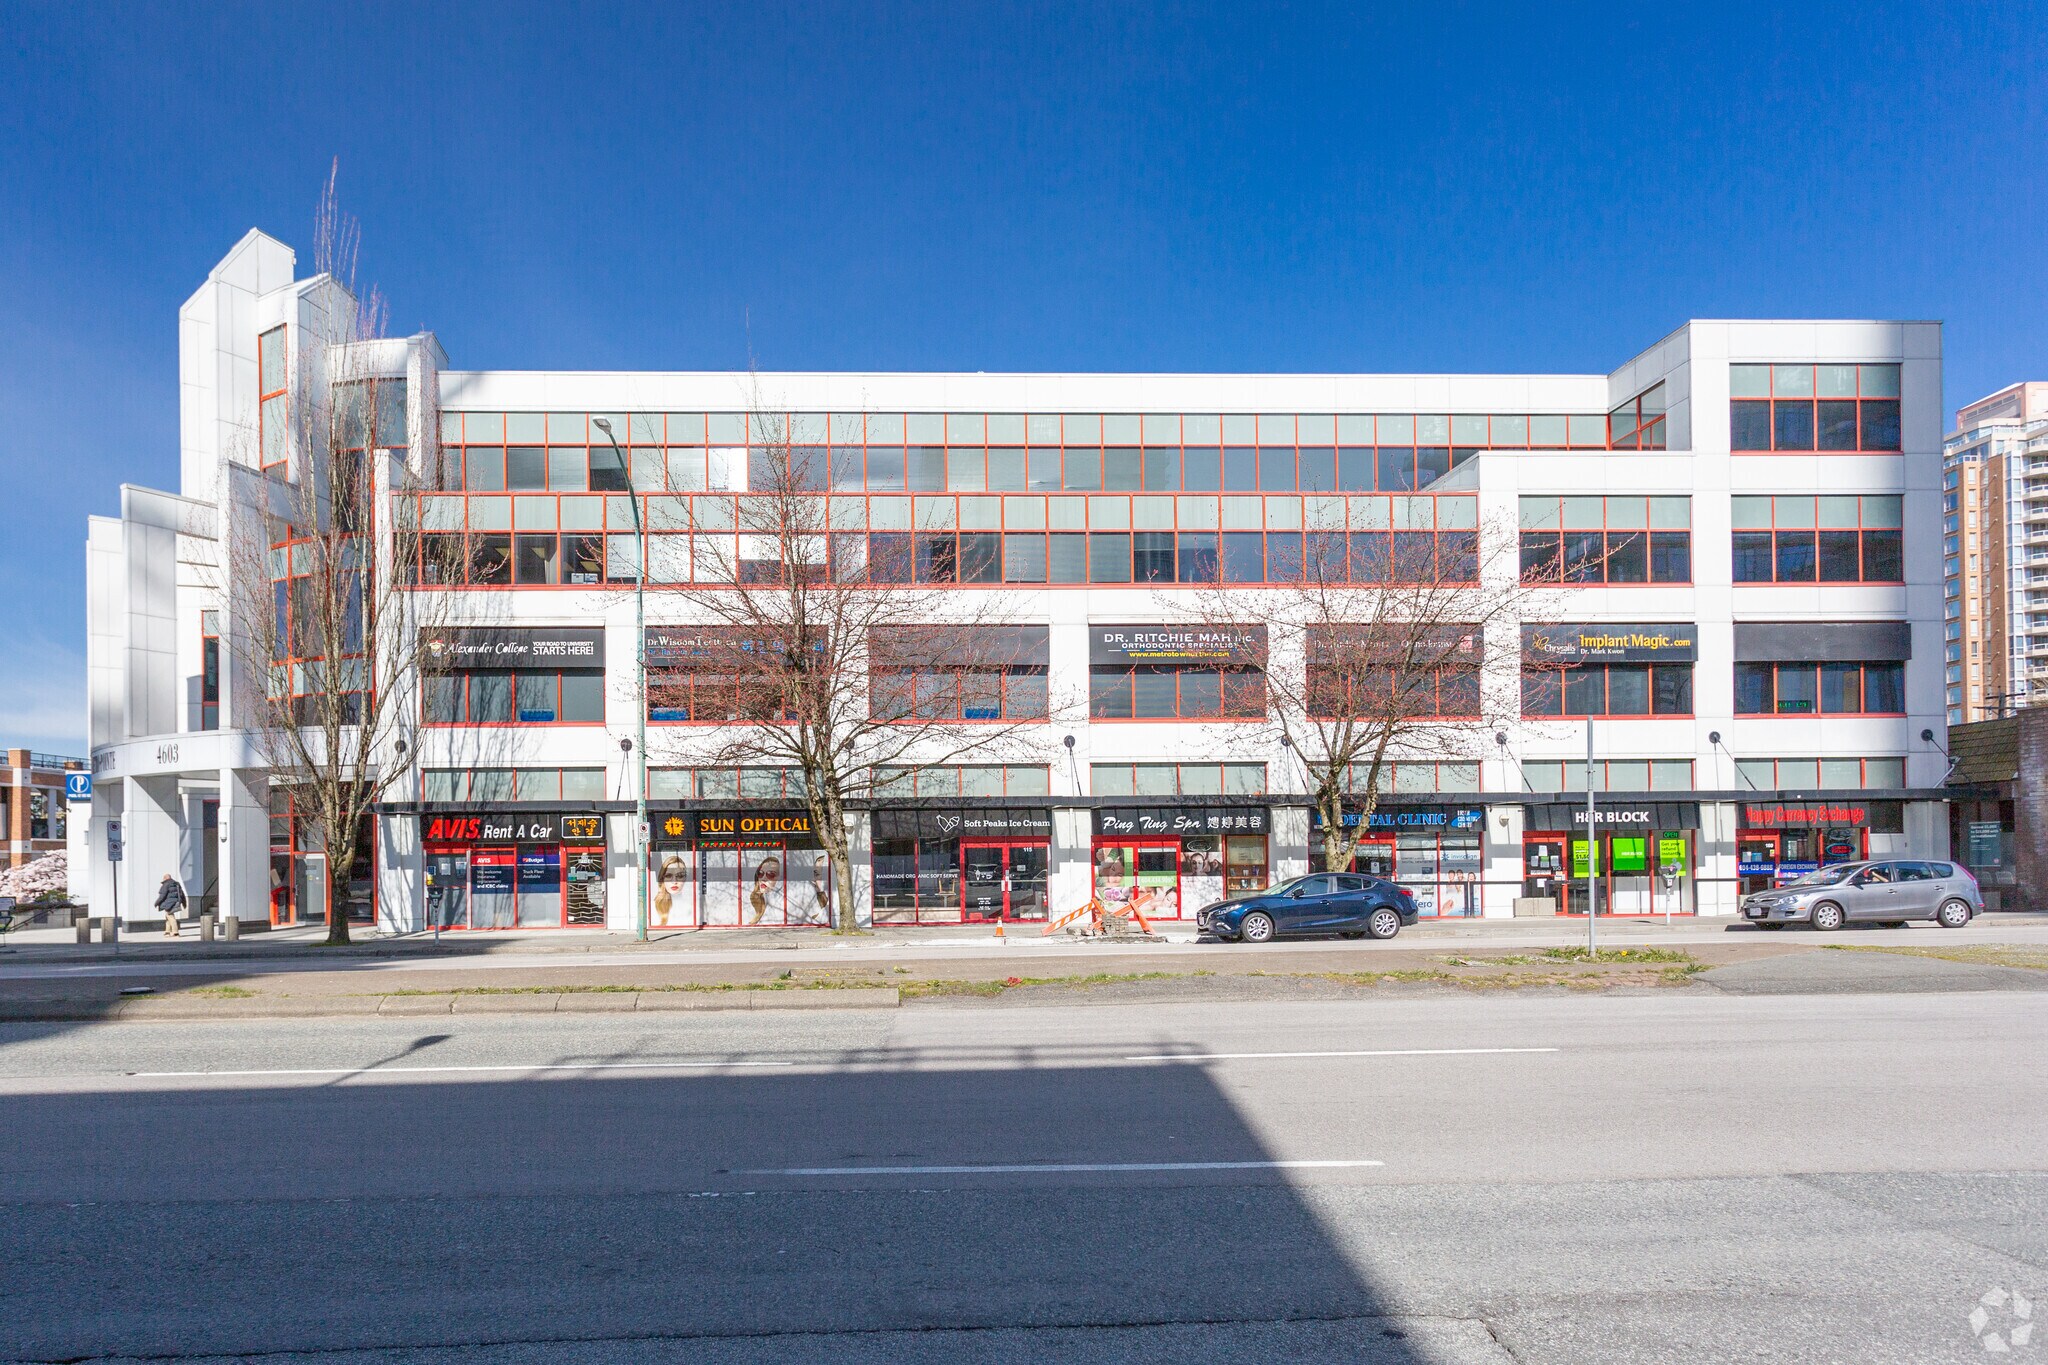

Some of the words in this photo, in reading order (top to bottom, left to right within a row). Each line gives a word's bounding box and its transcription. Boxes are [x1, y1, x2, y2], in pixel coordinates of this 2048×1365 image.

[1104, 634, 1128, 643] DR.
[1135, 634, 1193, 643] RITCHIE
[1199, 634, 1231, 643] MAH
[1579, 634, 1628, 649] Implant
[444, 642, 494, 654] Alexander
[495, 642, 528, 655] College
[532, 647, 566, 655] STARTS
[567, 647, 594, 655] HERE!
[157, 744, 179, 764] 4603
[1397, 813, 1447, 825] CLINIC
[1576, 811, 1603, 823] H&R
[1607, 811, 1649, 823] BLOCK
[1746, 806, 1774, 825] Happy
[1776, 806, 1818, 824] Currency
[1819, 806, 1865, 824] Exchange
[700, 818, 734, 831] SUN
[740, 818, 811, 831] OPTICAL
[964, 819, 982, 827] Soft
[983, 819, 1007, 827] Peaks
[1009, 819, 1021, 827] Ice
[1023, 819, 1051, 827] Cream
[1103, 816, 1134, 832] Ping
[1139, 816, 1168, 832] Ting
[1173, 816, 1201, 831] Spa
[483, 824, 512, 839] Rent
[516, 824, 526, 838] A
[530, 823, 552, 839] Car
